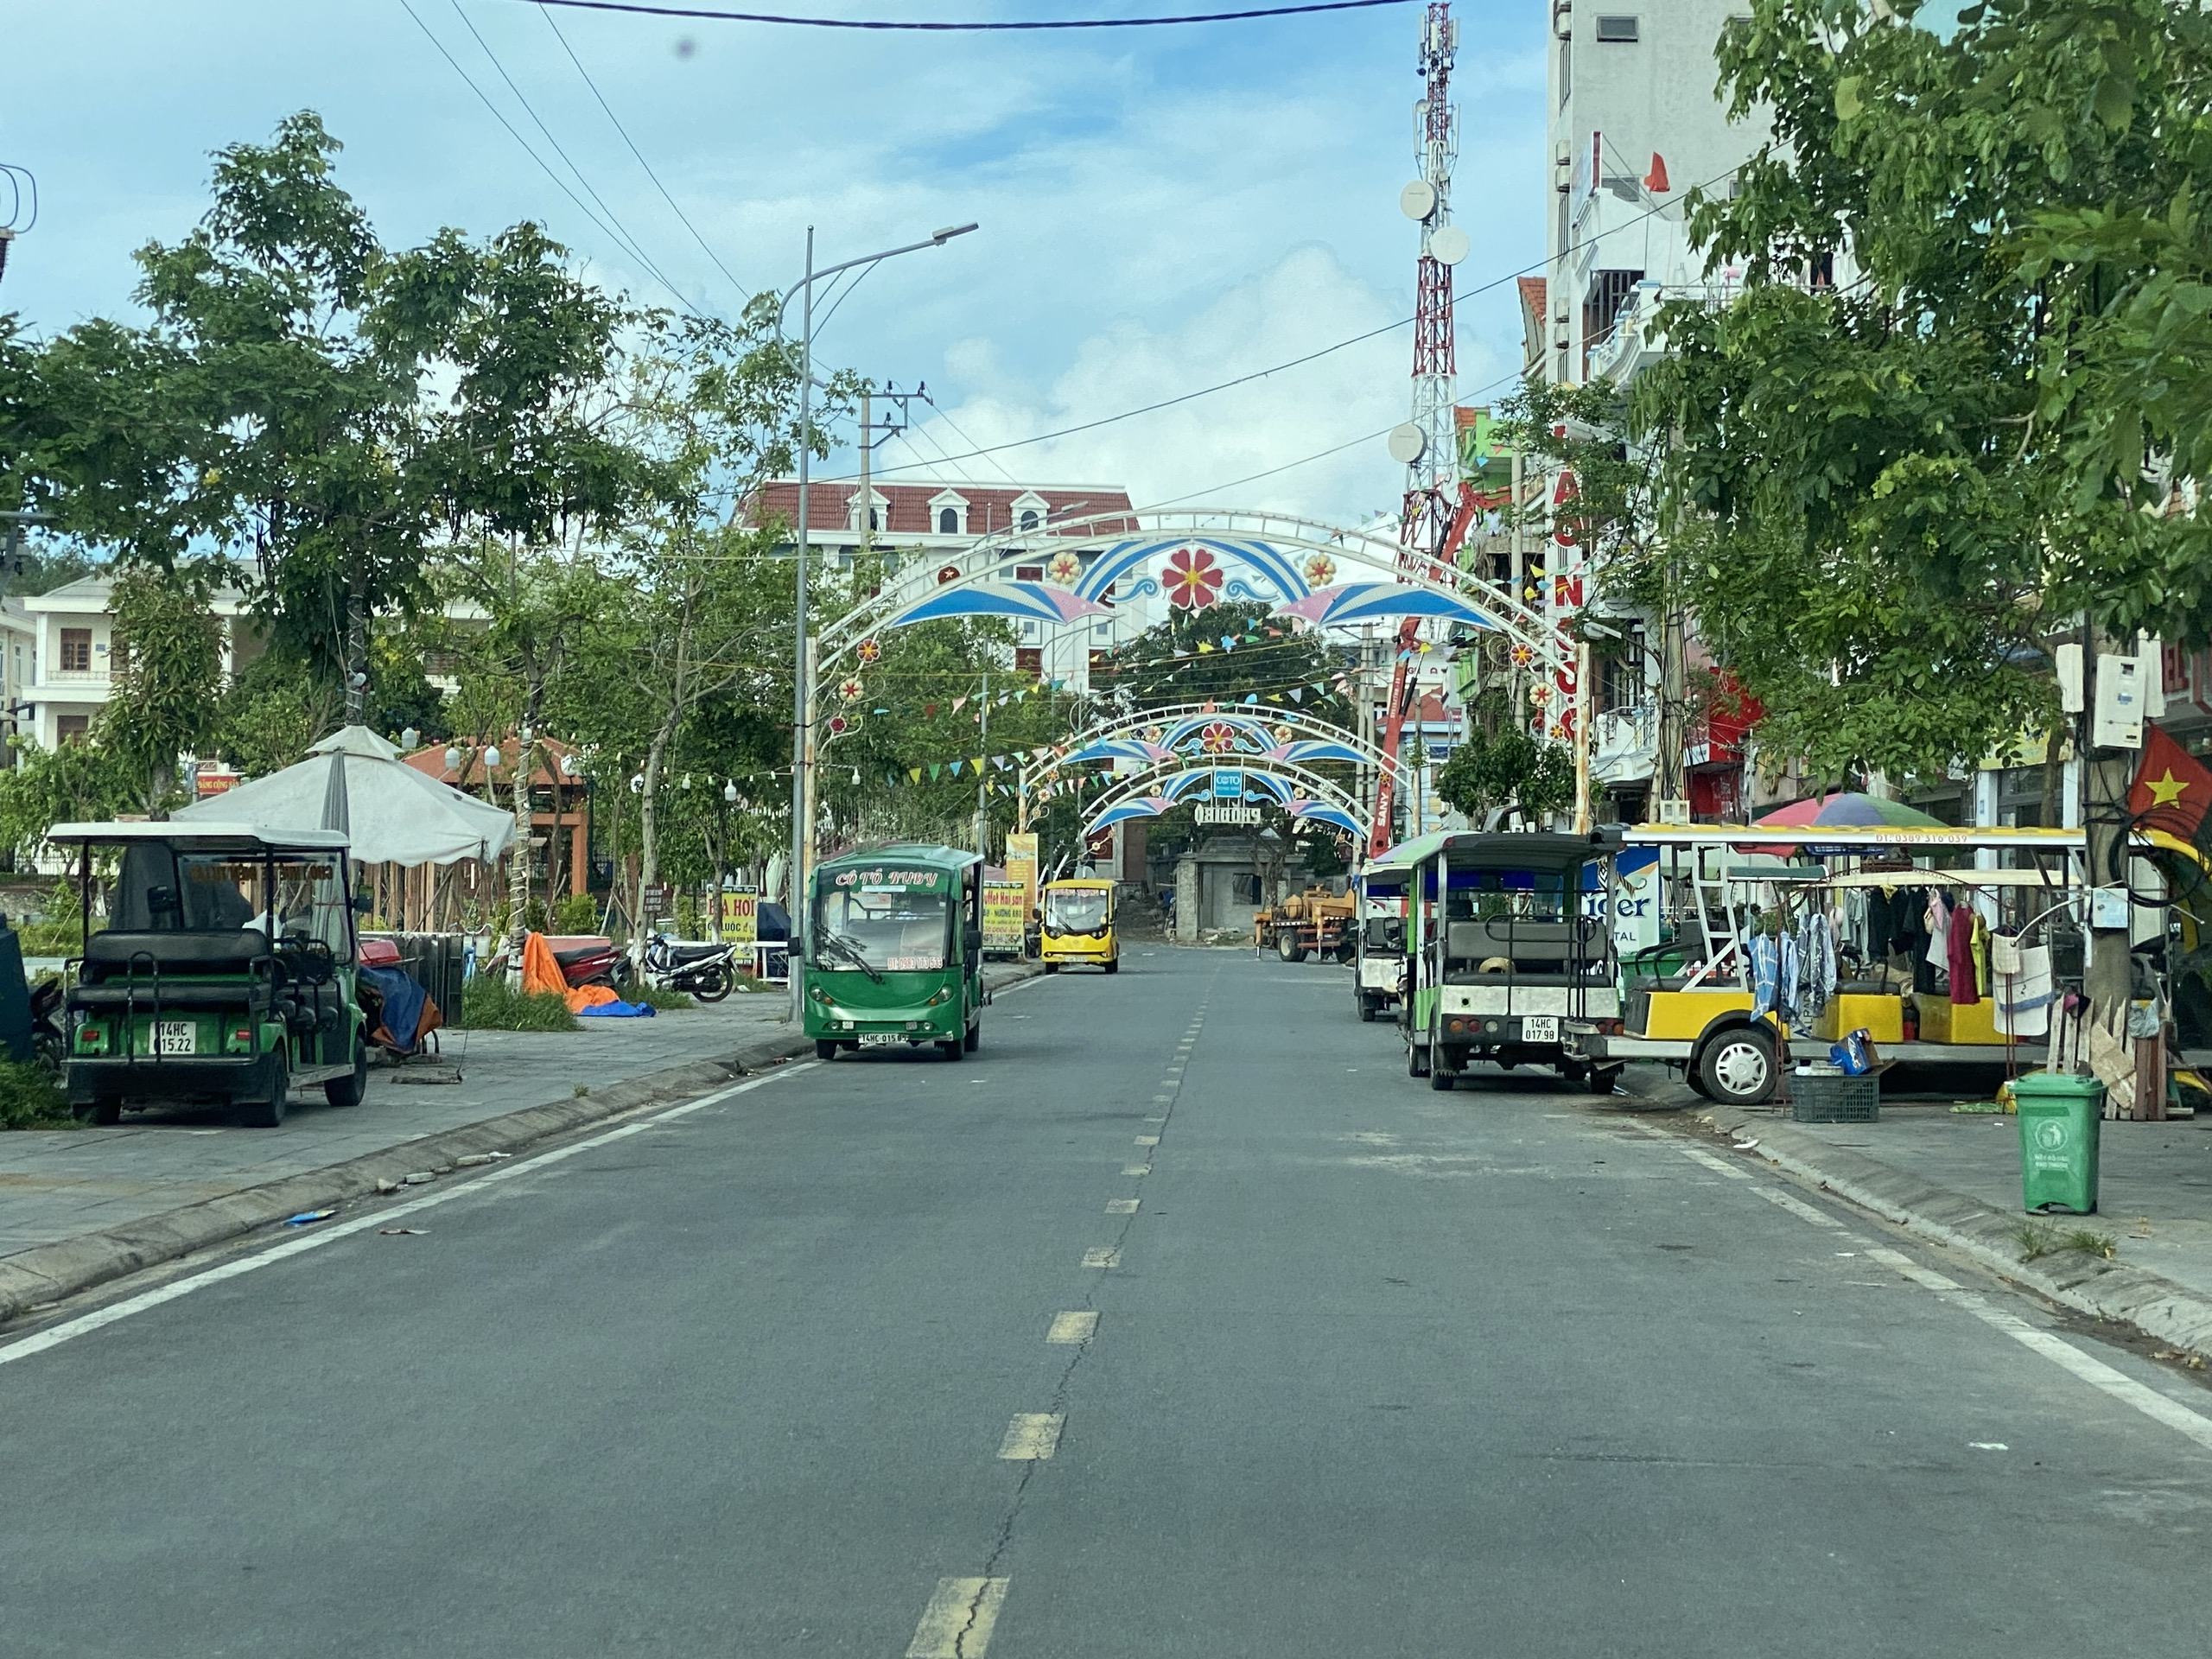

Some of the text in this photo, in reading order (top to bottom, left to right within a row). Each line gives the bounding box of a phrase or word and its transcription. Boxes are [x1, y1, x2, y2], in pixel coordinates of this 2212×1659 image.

[1377, 792, 1389, 827] SANY
[1895, 834, 1921, 843] 0389
[1925, 835, 1944, 843] 316
[1948, 835, 1967, 844] 039
[836, 868, 938, 888] CÔ TÔ RUBY
[733, 896, 755, 917] HƠI
[161, 1023, 187, 1036] 14HC
[1531, 1019, 1551, 1028] 14HC
[1525, 1030, 1554, 1039] 017.98
